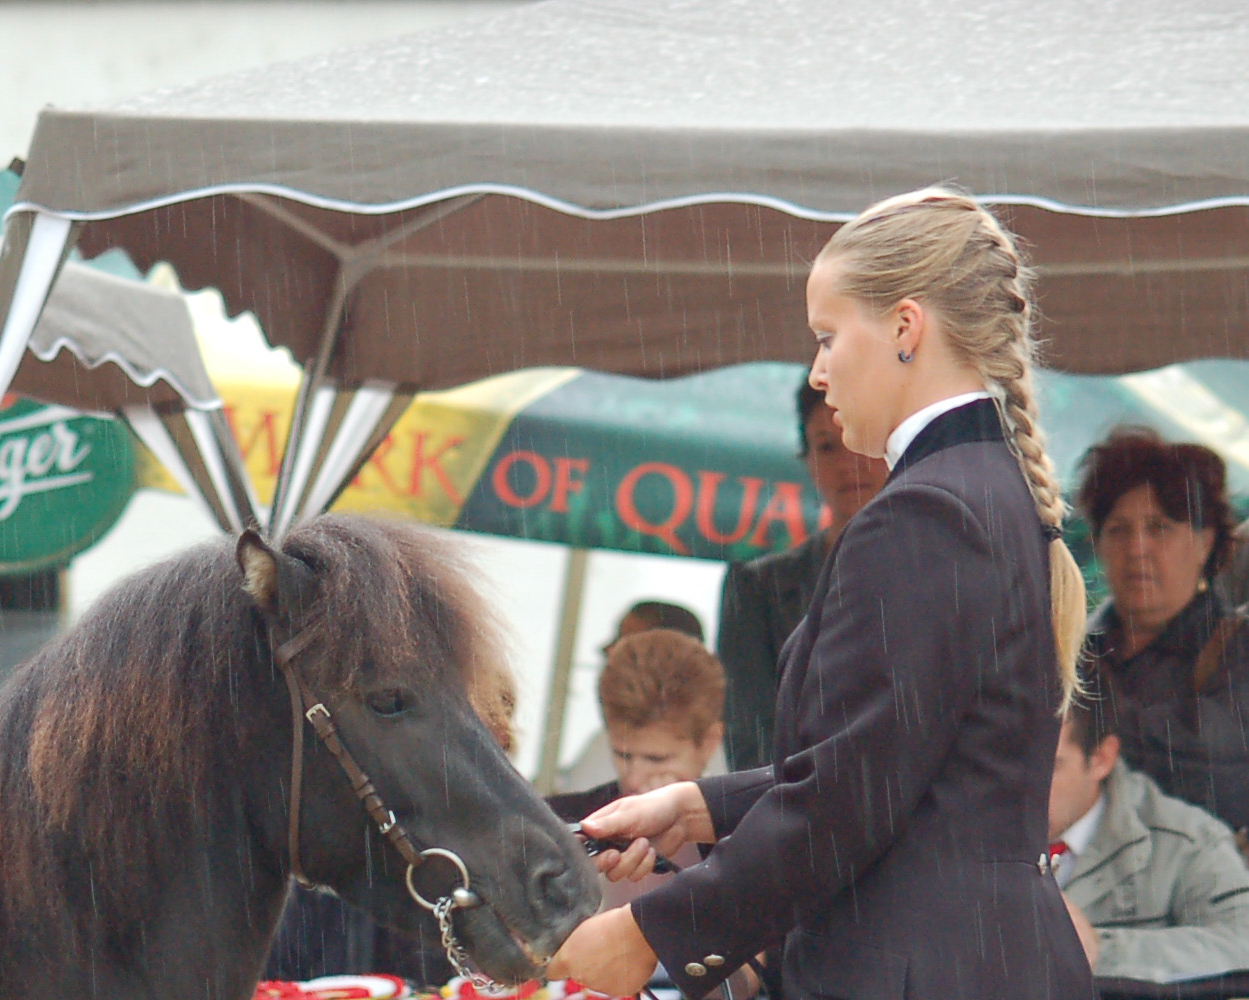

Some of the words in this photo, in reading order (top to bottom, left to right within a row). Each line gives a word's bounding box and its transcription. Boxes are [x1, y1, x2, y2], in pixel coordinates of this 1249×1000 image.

[222, 405, 465, 506] MRK
[493, 449, 590, 514] OF
[615, 461, 833, 554] QUA
